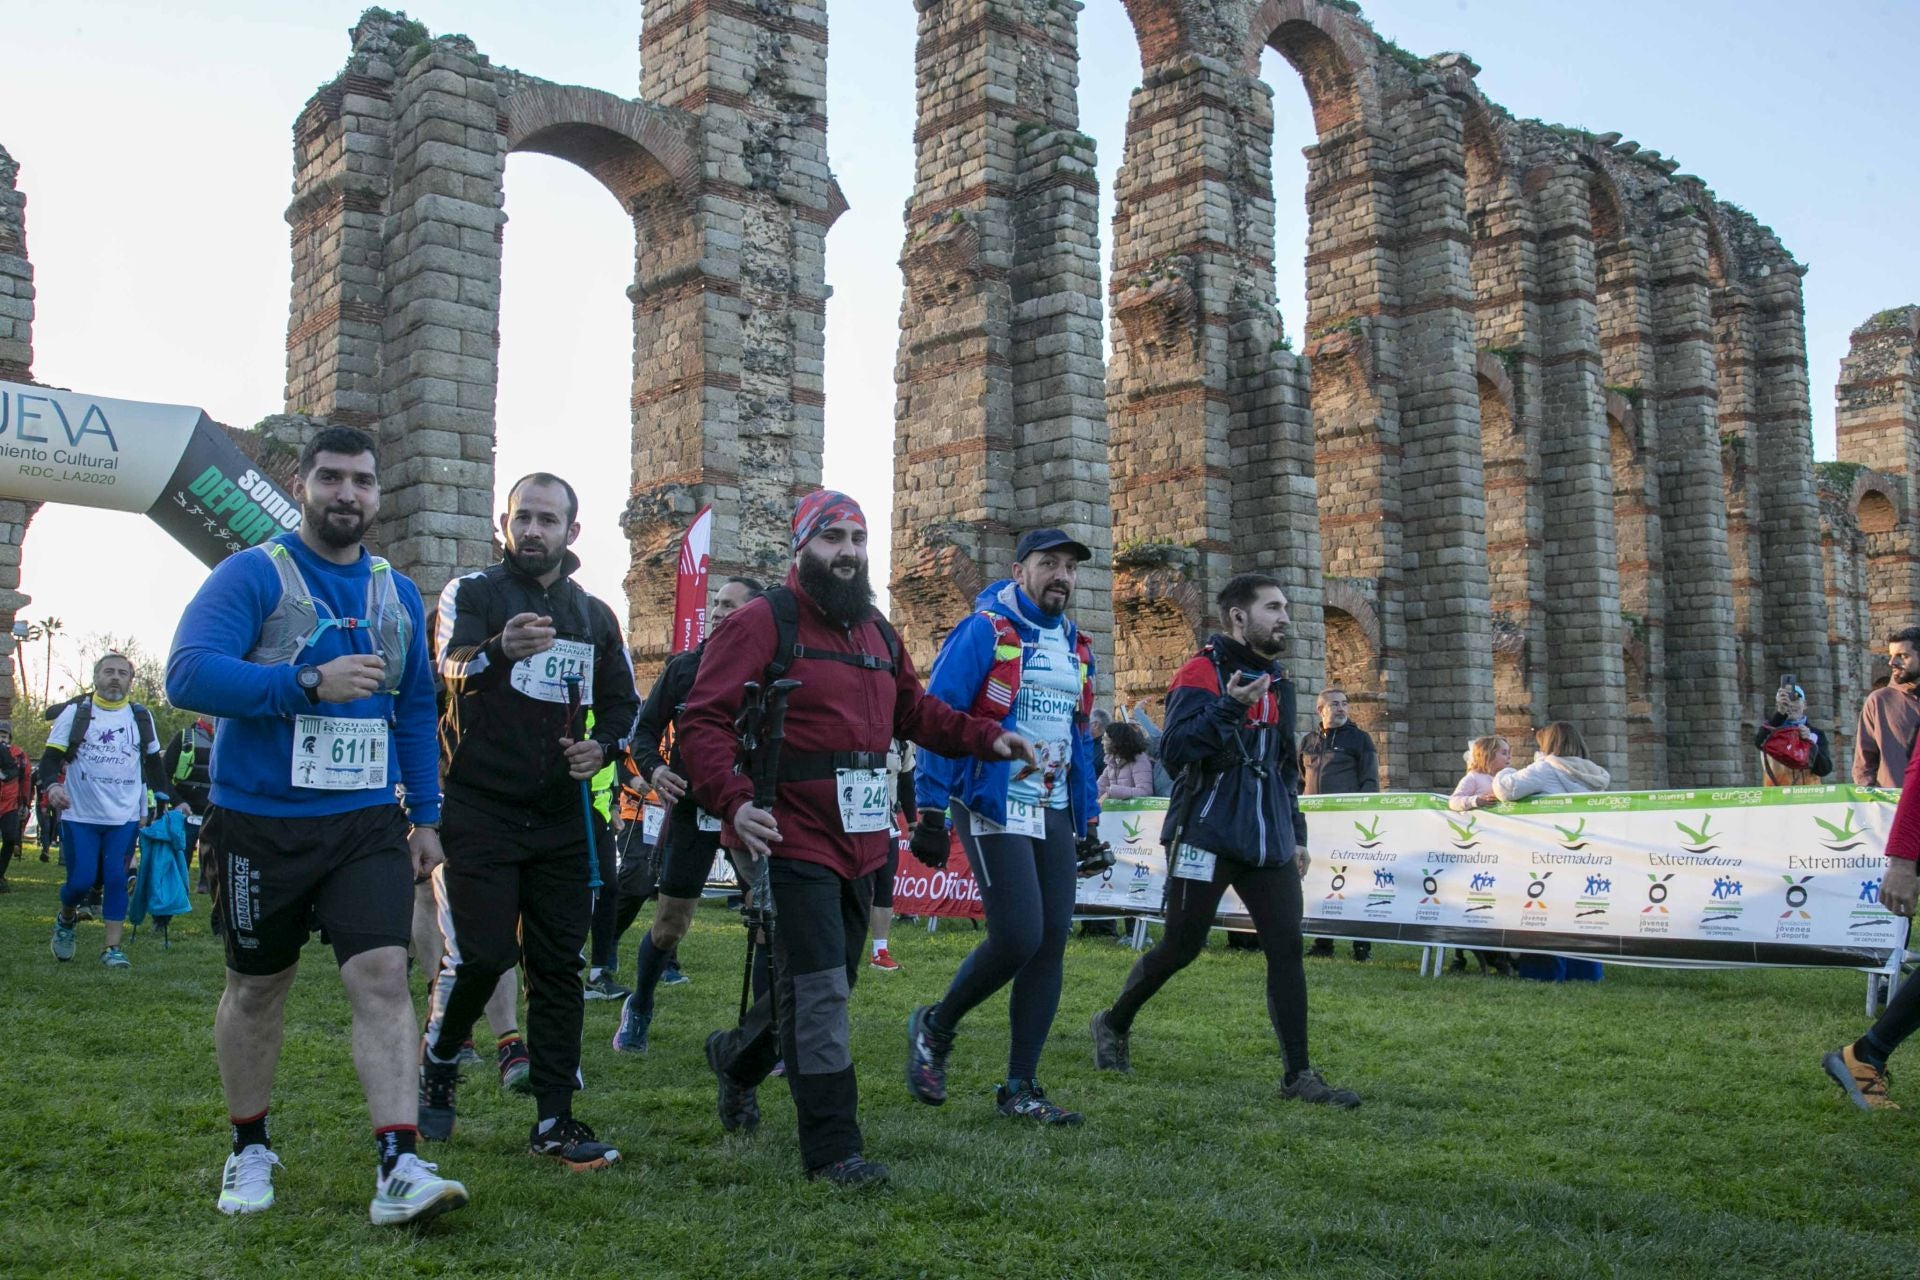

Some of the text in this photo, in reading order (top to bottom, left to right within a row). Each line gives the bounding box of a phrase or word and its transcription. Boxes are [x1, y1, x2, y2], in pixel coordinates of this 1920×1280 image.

[53, 449, 118, 470] Cultural
[19, 464, 116, 485] RDC_LA2020
[238, 469, 303, 532] SOMO
[545, 656, 575, 678] 617
[332, 738, 365, 764] 611
[863, 786, 887, 808] 242
[1330, 849, 1397, 862] Extremadura
[1427, 851, 1499, 865] Extremadura
[1531, 851, 1613, 865] Extremadura
[1649, 852, 1742, 867] Extremadura
